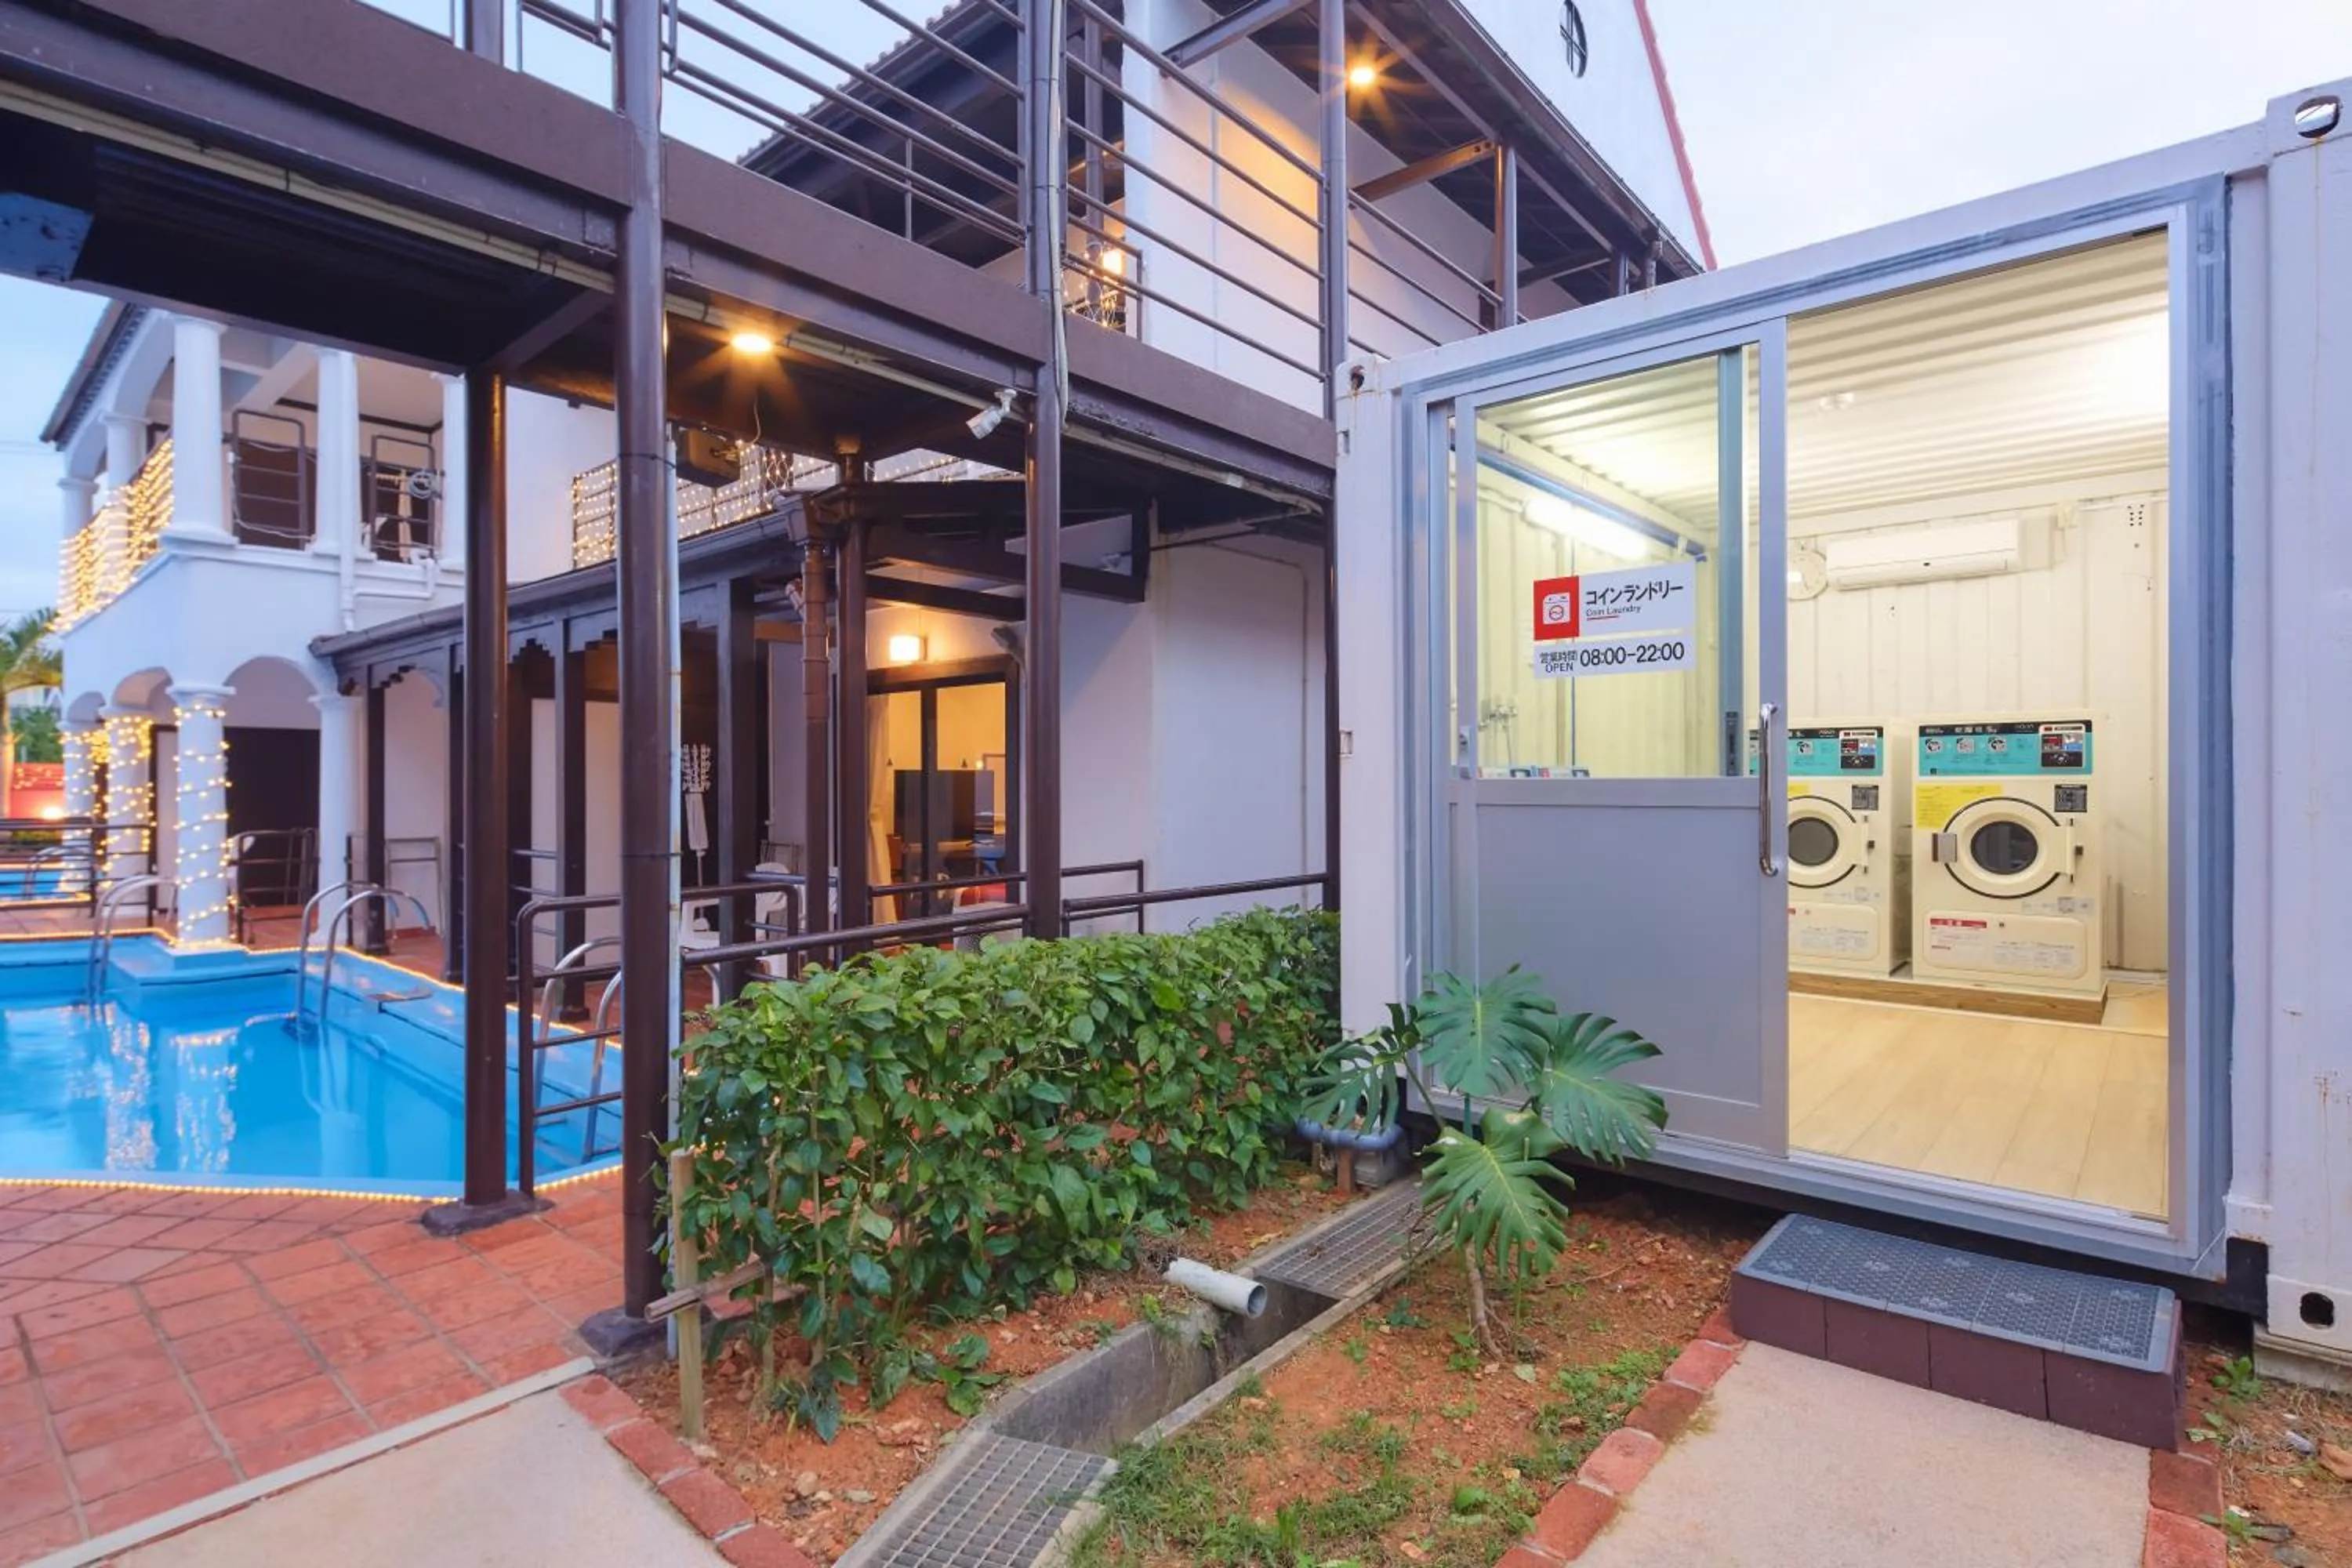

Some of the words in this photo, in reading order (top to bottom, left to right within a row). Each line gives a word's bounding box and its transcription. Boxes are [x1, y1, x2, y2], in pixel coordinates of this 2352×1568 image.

[1586, 579, 1683, 604] コインランドリー
[1586, 608, 1605, 617] Coin
[1607, 604, 1642, 615] Laundry
[1540, 650, 1577, 665] 営業時間
[1545, 662, 1573, 673] OPEN
